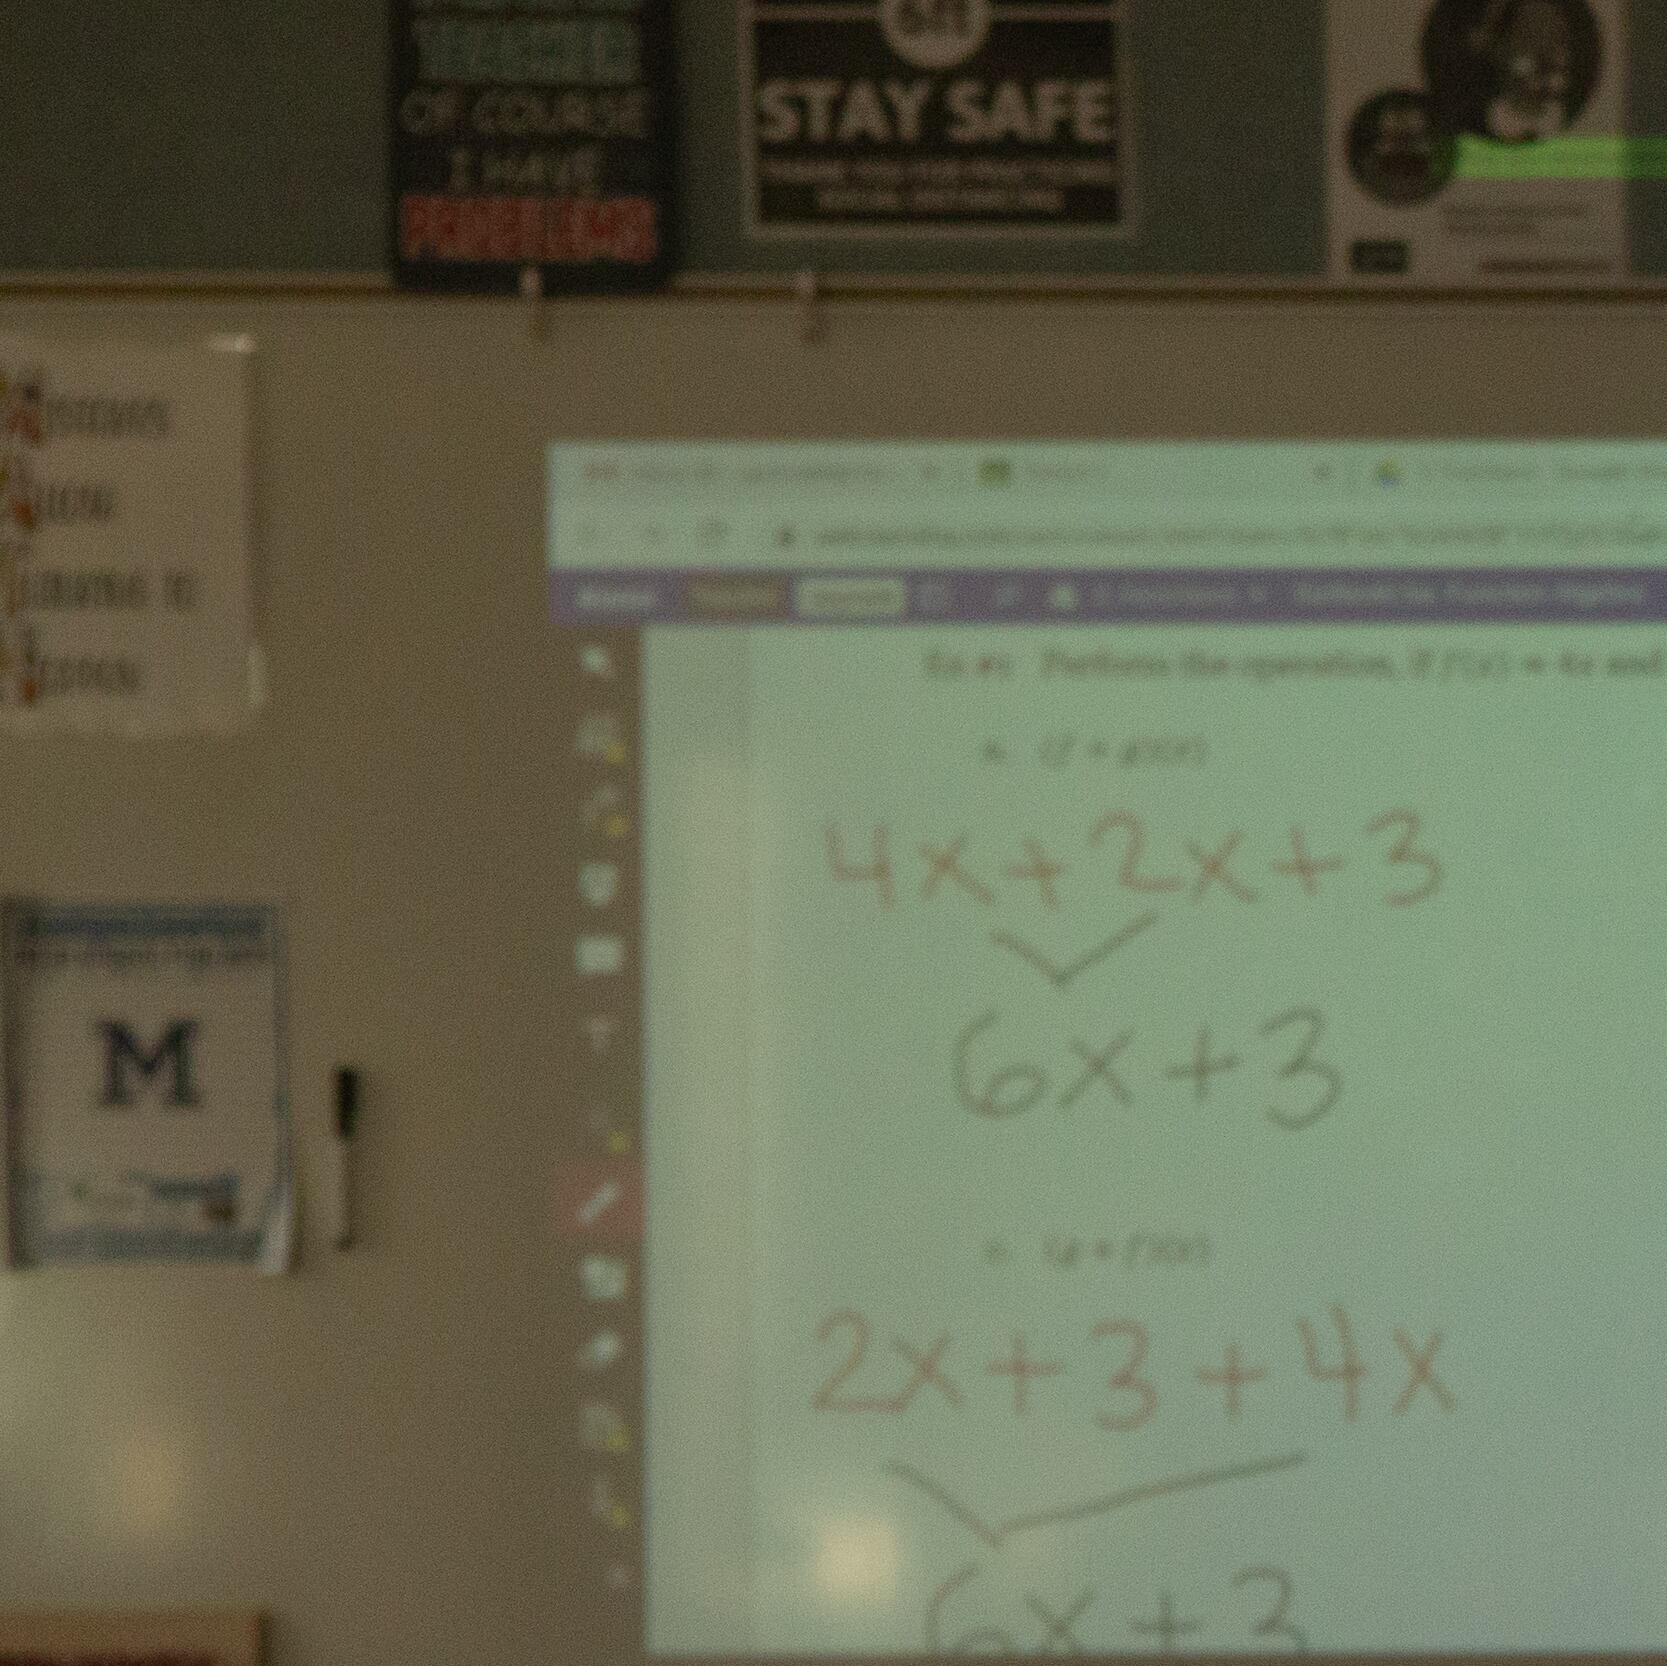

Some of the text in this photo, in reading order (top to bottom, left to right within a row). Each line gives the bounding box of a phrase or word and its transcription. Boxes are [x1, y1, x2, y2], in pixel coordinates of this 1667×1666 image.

[758, 79, 1113, 142] STAY SAFE
[95, 1019, 202, 1108] M
